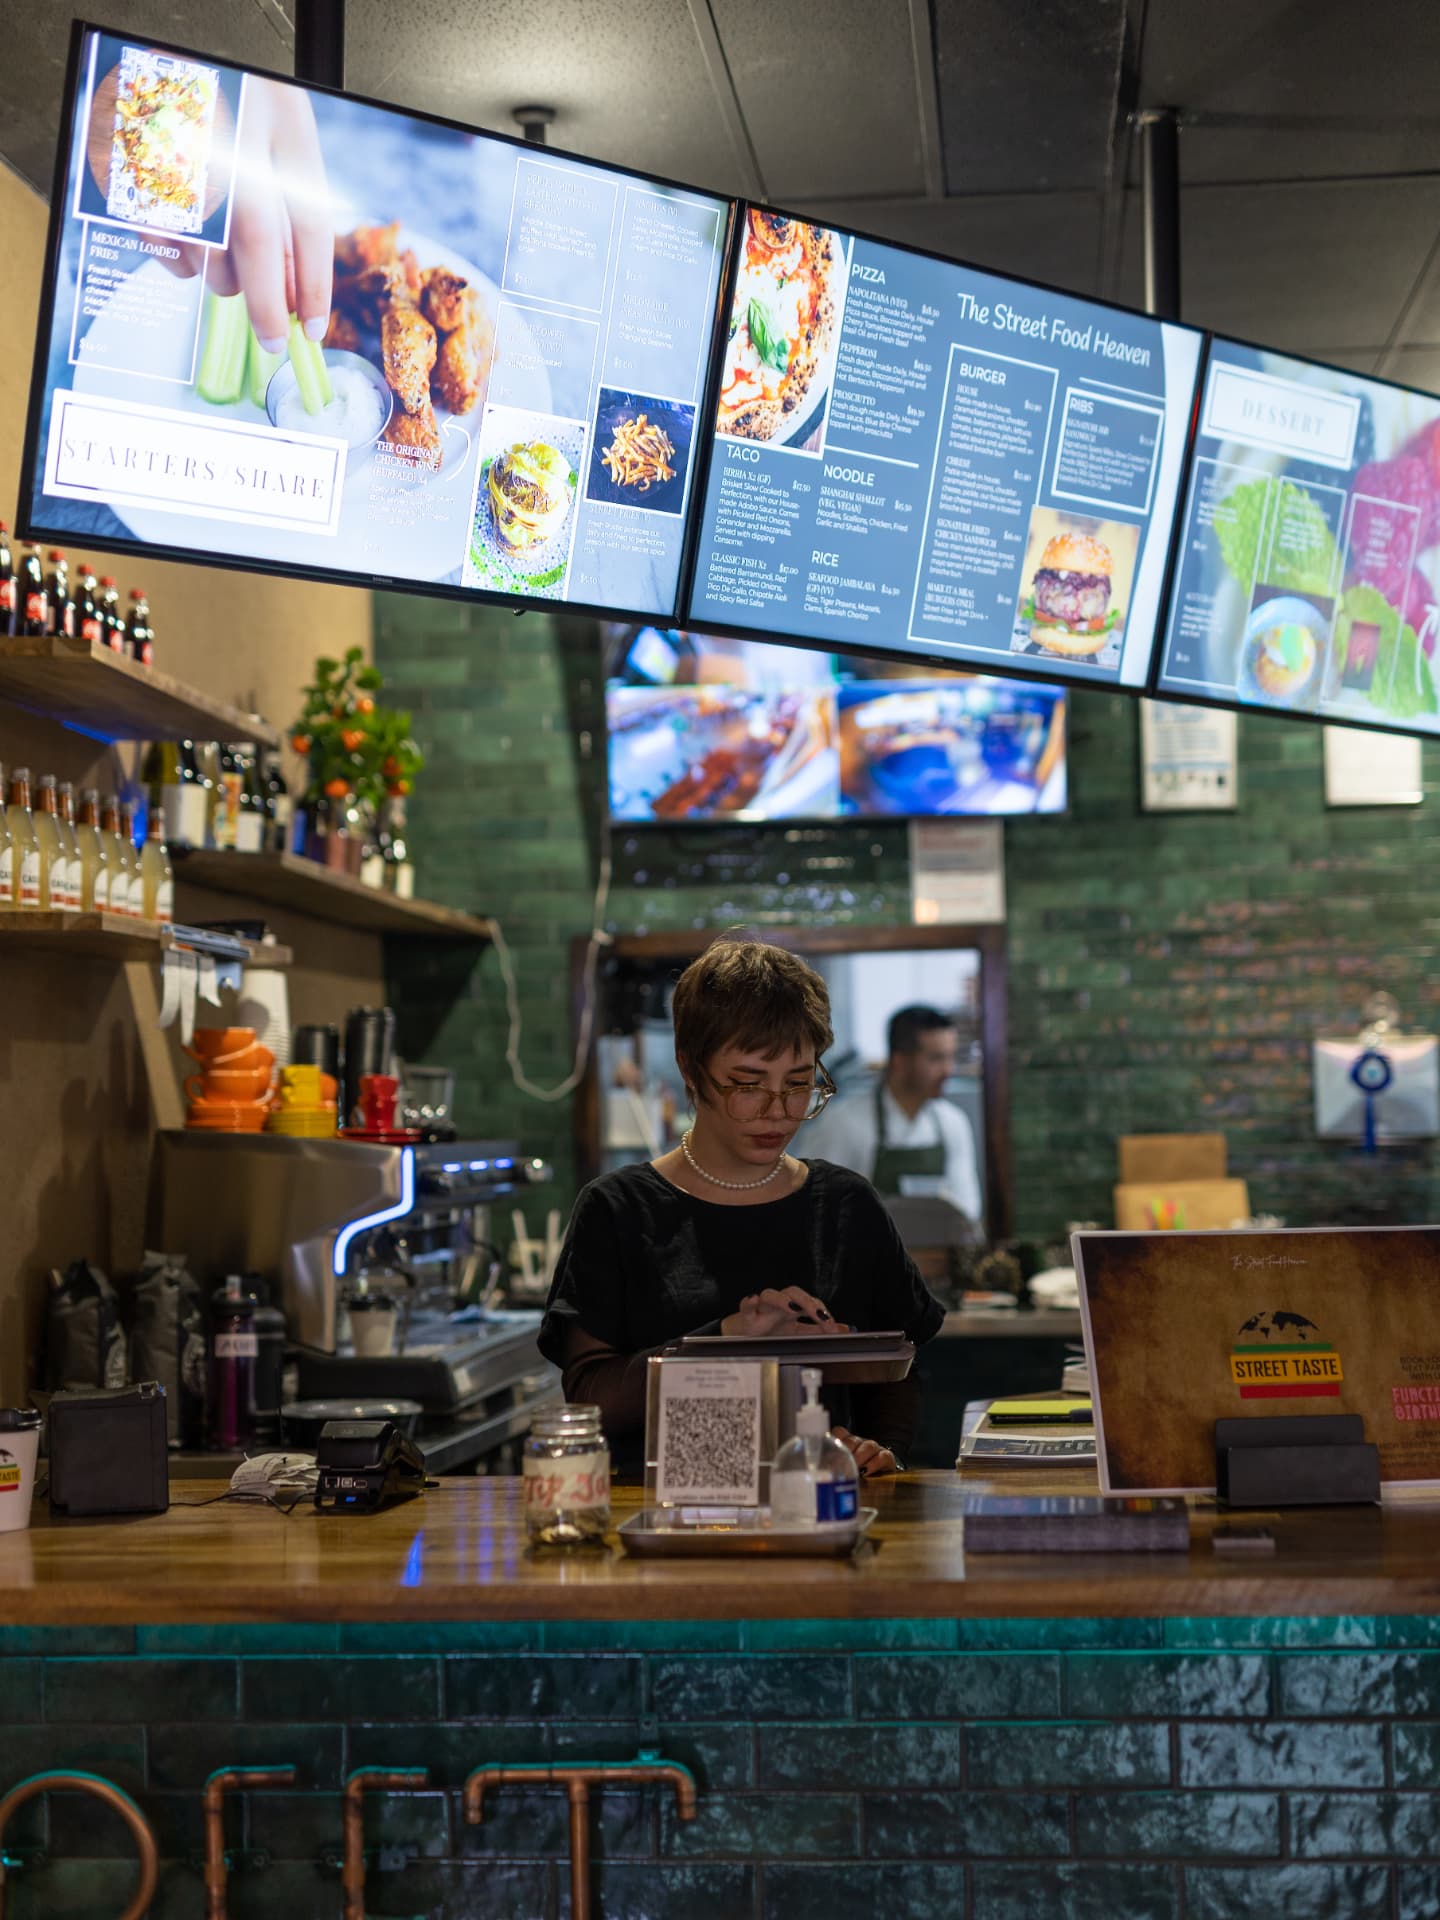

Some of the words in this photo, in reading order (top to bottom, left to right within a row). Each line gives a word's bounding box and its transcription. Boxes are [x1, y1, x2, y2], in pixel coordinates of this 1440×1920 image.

[90, 245, 119, 261] FRIES
[92, 231, 138, 251] MEXICAN
[139, 242, 181, 260] LOADED
[851, 263, 887, 284] PIZZA
[849, 285, 889, 304] NAPOLITANA
[846, 306, 860, 316] Pizza
[911, 323, 924, 333] and
[847, 297, 863, 308] Fresh
[863, 302, 883, 314] dough
[883, 307, 900, 318] made
[916, 315, 935, 327] House
[843, 325, 857, 335] Basil
[857, 328, 867, 337] Oil
[867, 331, 878, 340] and
[878, 334, 894, 344] Fresh
[844, 316, 864, 328] Cherry
[864, 321, 892, 335] Tomatoes
[892, 328, 913, 340] topped
[913, 333, 927, 344] with
[954, 291, 991, 326] The
[992, 302, 1049, 341] Street
[1051, 315, 1093, 352] Food
[1093, 329, 1153, 368] Heaven
[840, 342, 877, 359] PEPPERONI
[836, 371, 847, 381] Hot
[838, 362, 853, 373] Pizza
[903, 378, 915, 388] and
[915, 381, 927, 391] and
[839, 353, 855, 364] Fresh
[855, 357, 875, 369] dough
[875, 362, 892, 373] made
[908, 370, 927, 382] House
[959, 362, 1007, 386] BURGER
[834, 389, 876, 407] PROSCIUTTO
[1069, 396, 1095, 415] RIBS
[831, 409, 846, 419] Pizza
[864, 416, 879, 427] Blue
[879, 420, 891, 429] Brie
[891, 423, 912, 434] Cheese
[832, 399, 848, 411] Fresh
[848, 403, 868, 416] dough
[868, 408, 886, 420] made
[901, 415, 920, 428] House
[1241, 399, 1326, 436] DESSERT
[830, 419, 851, 430] topped
[850, 423, 864, 433] with
[377, 441, 394, 453] THE
[395, 443, 440, 460] ORIGINAL
[725, 444, 761, 463] TACO
[375, 454, 415, 469] CHICKEN
[415, 460, 439, 473] WING
[757, 473, 772, 486] (GF)
[823, 463, 875, 487] NOODLE
[720, 488, 753, 501] Perfection,
[754, 494, 767, 503] with
[768, 497, 778, 506] our
[721, 478, 743, 489] Brisket
[744, 482, 758, 492] Slow
[759, 486, 782, 497] Cooked
[783, 490, 790, 498] to
[821, 486, 855, 501] SHANGHAI
[855, 492, 886, 507] SHALLOT
[717, 507, 732, 516] with
[733, 509, 754, 520] Pickled
[756, 514, 767, 523] Red
[719, 497, 737, 508] made
[738, 501, 758, 511] Adobo
[779, 509, 800, 520] Comes
[837, 500, 862, 515] VEGAN)
[716, 516, 746, 528] Coriander
[747, 522, 759, 530] and
[816, 517, 833, 527] Garlic
[833, 520, 845, 530] and
[893, 523, 908, 533] Fried
[715, 525, 736, 536] Served
[737, 530, 750, 539] with
[751, 532, 775, 543] dipping
[711, 552, 740, 565] CLASSIC
[741, 557, 757, 568] FISH
[811, 550, 840, 567] RICE
[710, 563, 737, 575] Battered
[737, 568, 774, 581] Barramundi,
[775, 574, 787, 584] Red
[809, 572, 839, 586] SEAFOOD
[840, 577, 876, 593] JAMBALAYA
[707, 582, 720, 591] Pico
[721, 584, 731, 593] De
[748, 589, 774, 600] Chipotle
[774, 593, 787, 602] Aioli
[738, 578, 760, 589] Pickled
[706, 592, 718, 601] and
[719, 594, 735, 604] Spicy
[736, 597, 748, 606] Red
[749, 599, 765, 608] Salsa
[820, 597, 834, 606] Tiger
[823, 606, 846, 617] Spanish
[1235, 1360, 1288, 1378] STREET
[1292, 1358, 1339, 1377] TASTE
[0, 1469, 19, 1481] ASTE
